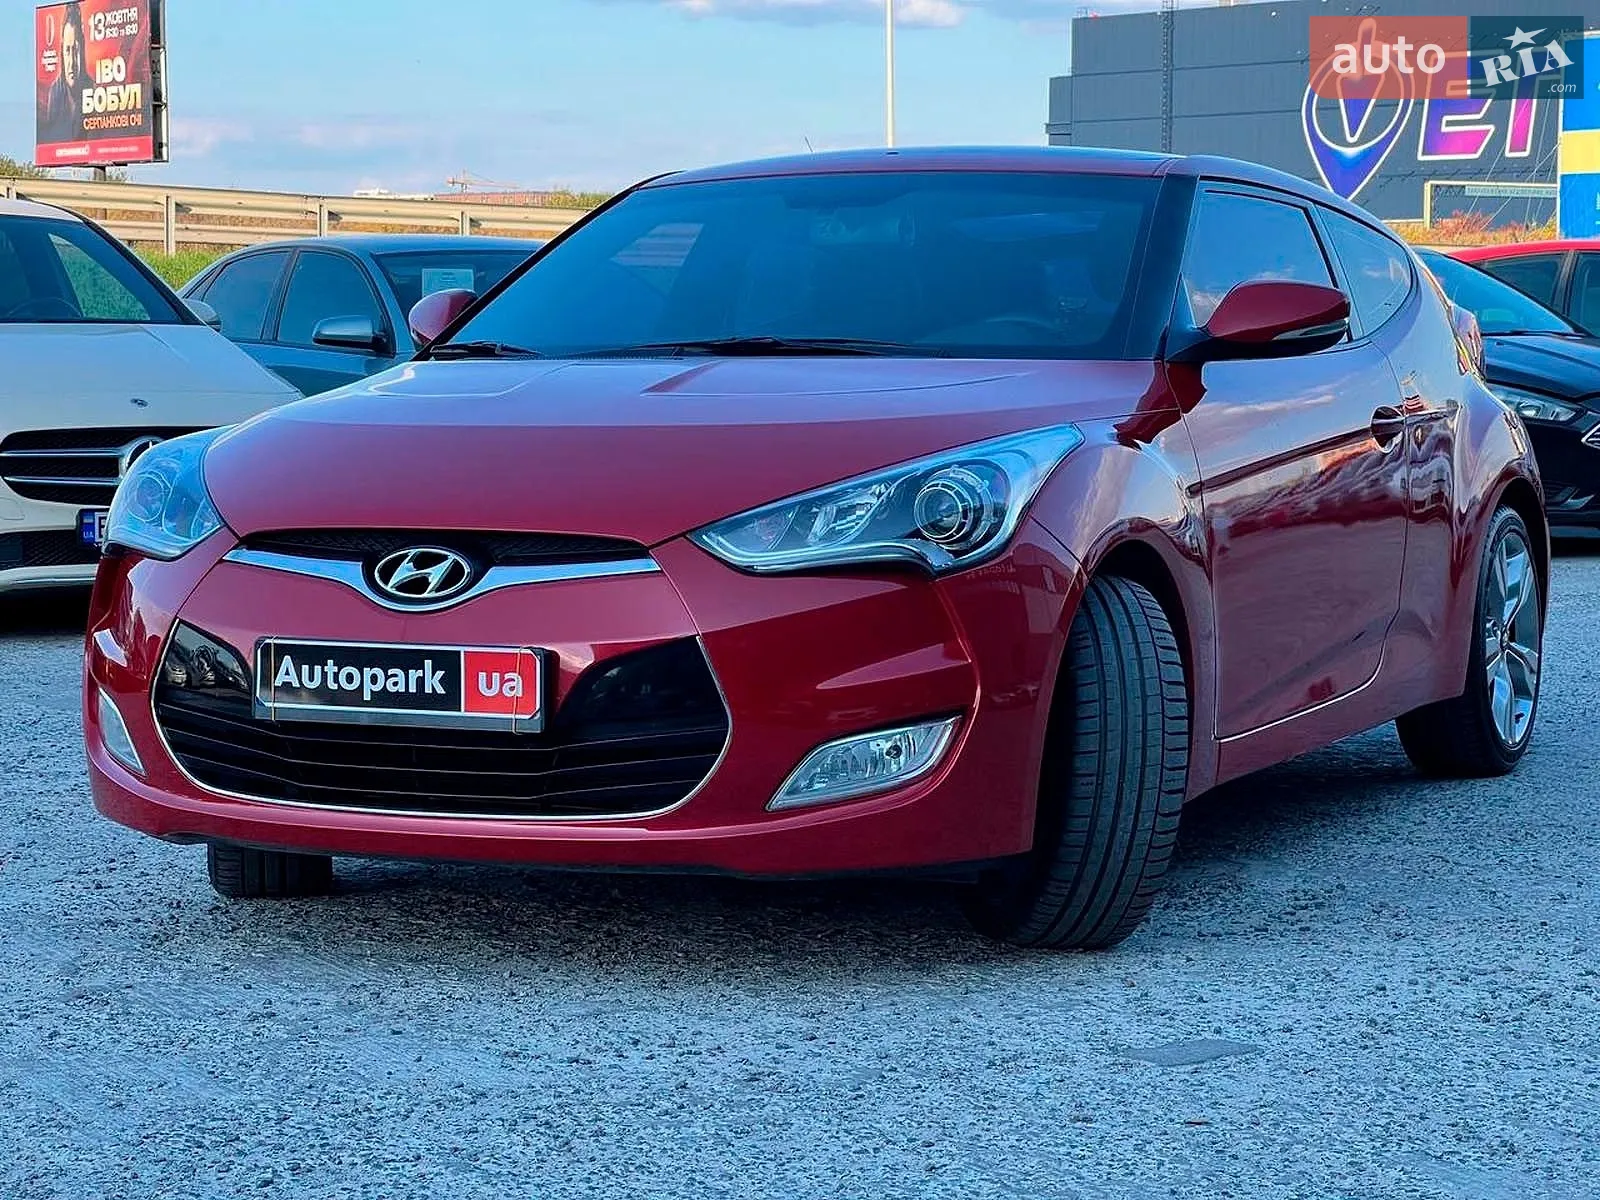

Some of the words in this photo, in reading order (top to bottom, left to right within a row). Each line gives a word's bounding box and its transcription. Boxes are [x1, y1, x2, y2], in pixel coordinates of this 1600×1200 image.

[88, 12, 105, 41] 13
[105, 7, 138, 26] ЖОВТНЯ
[95, 55, 126, 84] ІВО
[81, 83, 142, 114] БОБУЛ
[274, 655, 446, 700] Autopark
[477, 670, 523, 697] ua
